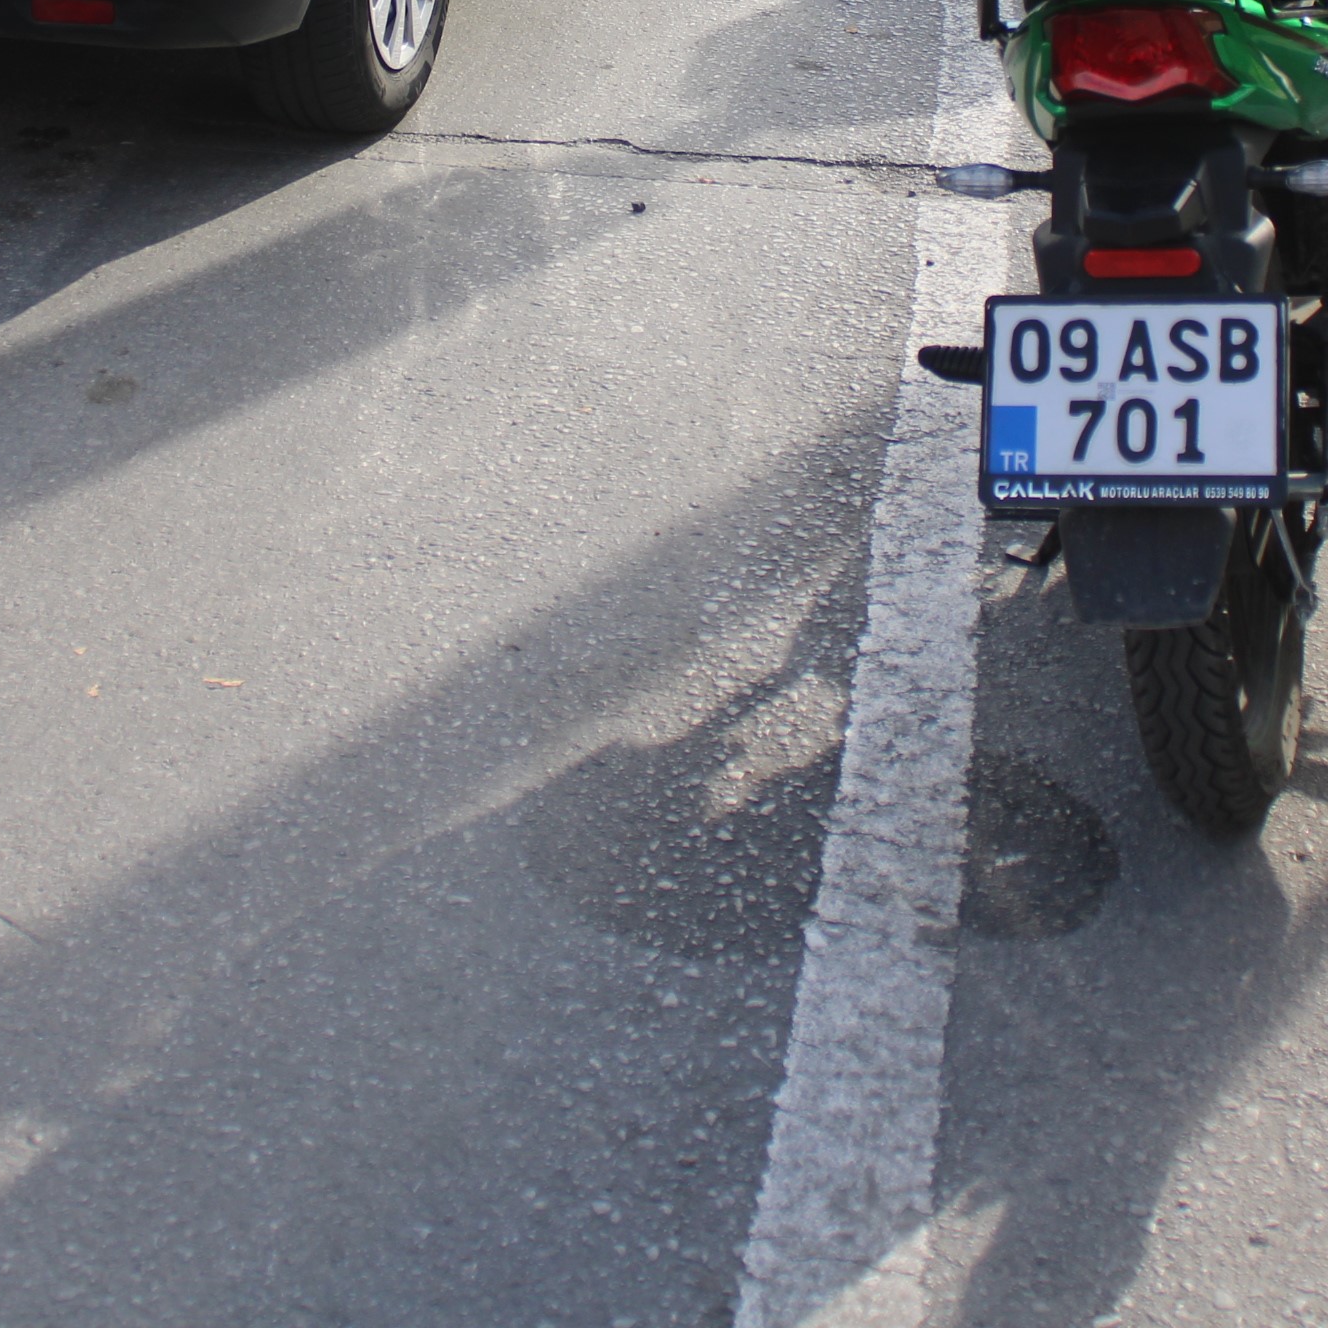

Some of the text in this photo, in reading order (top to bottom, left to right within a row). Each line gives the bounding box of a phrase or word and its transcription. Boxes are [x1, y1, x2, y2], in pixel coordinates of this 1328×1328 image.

[1010, 318, 1260, 384] 09 ASB
[1000, 398, 1205, 472] TR 701
[993, 481, 1095, 501] ÇALLAK
[1100, 486, 1150, 500] MOTORLU
[1150, 486, 1199, 502] ARAÇLAR
[1205, 487, 1226, 499] 0539
